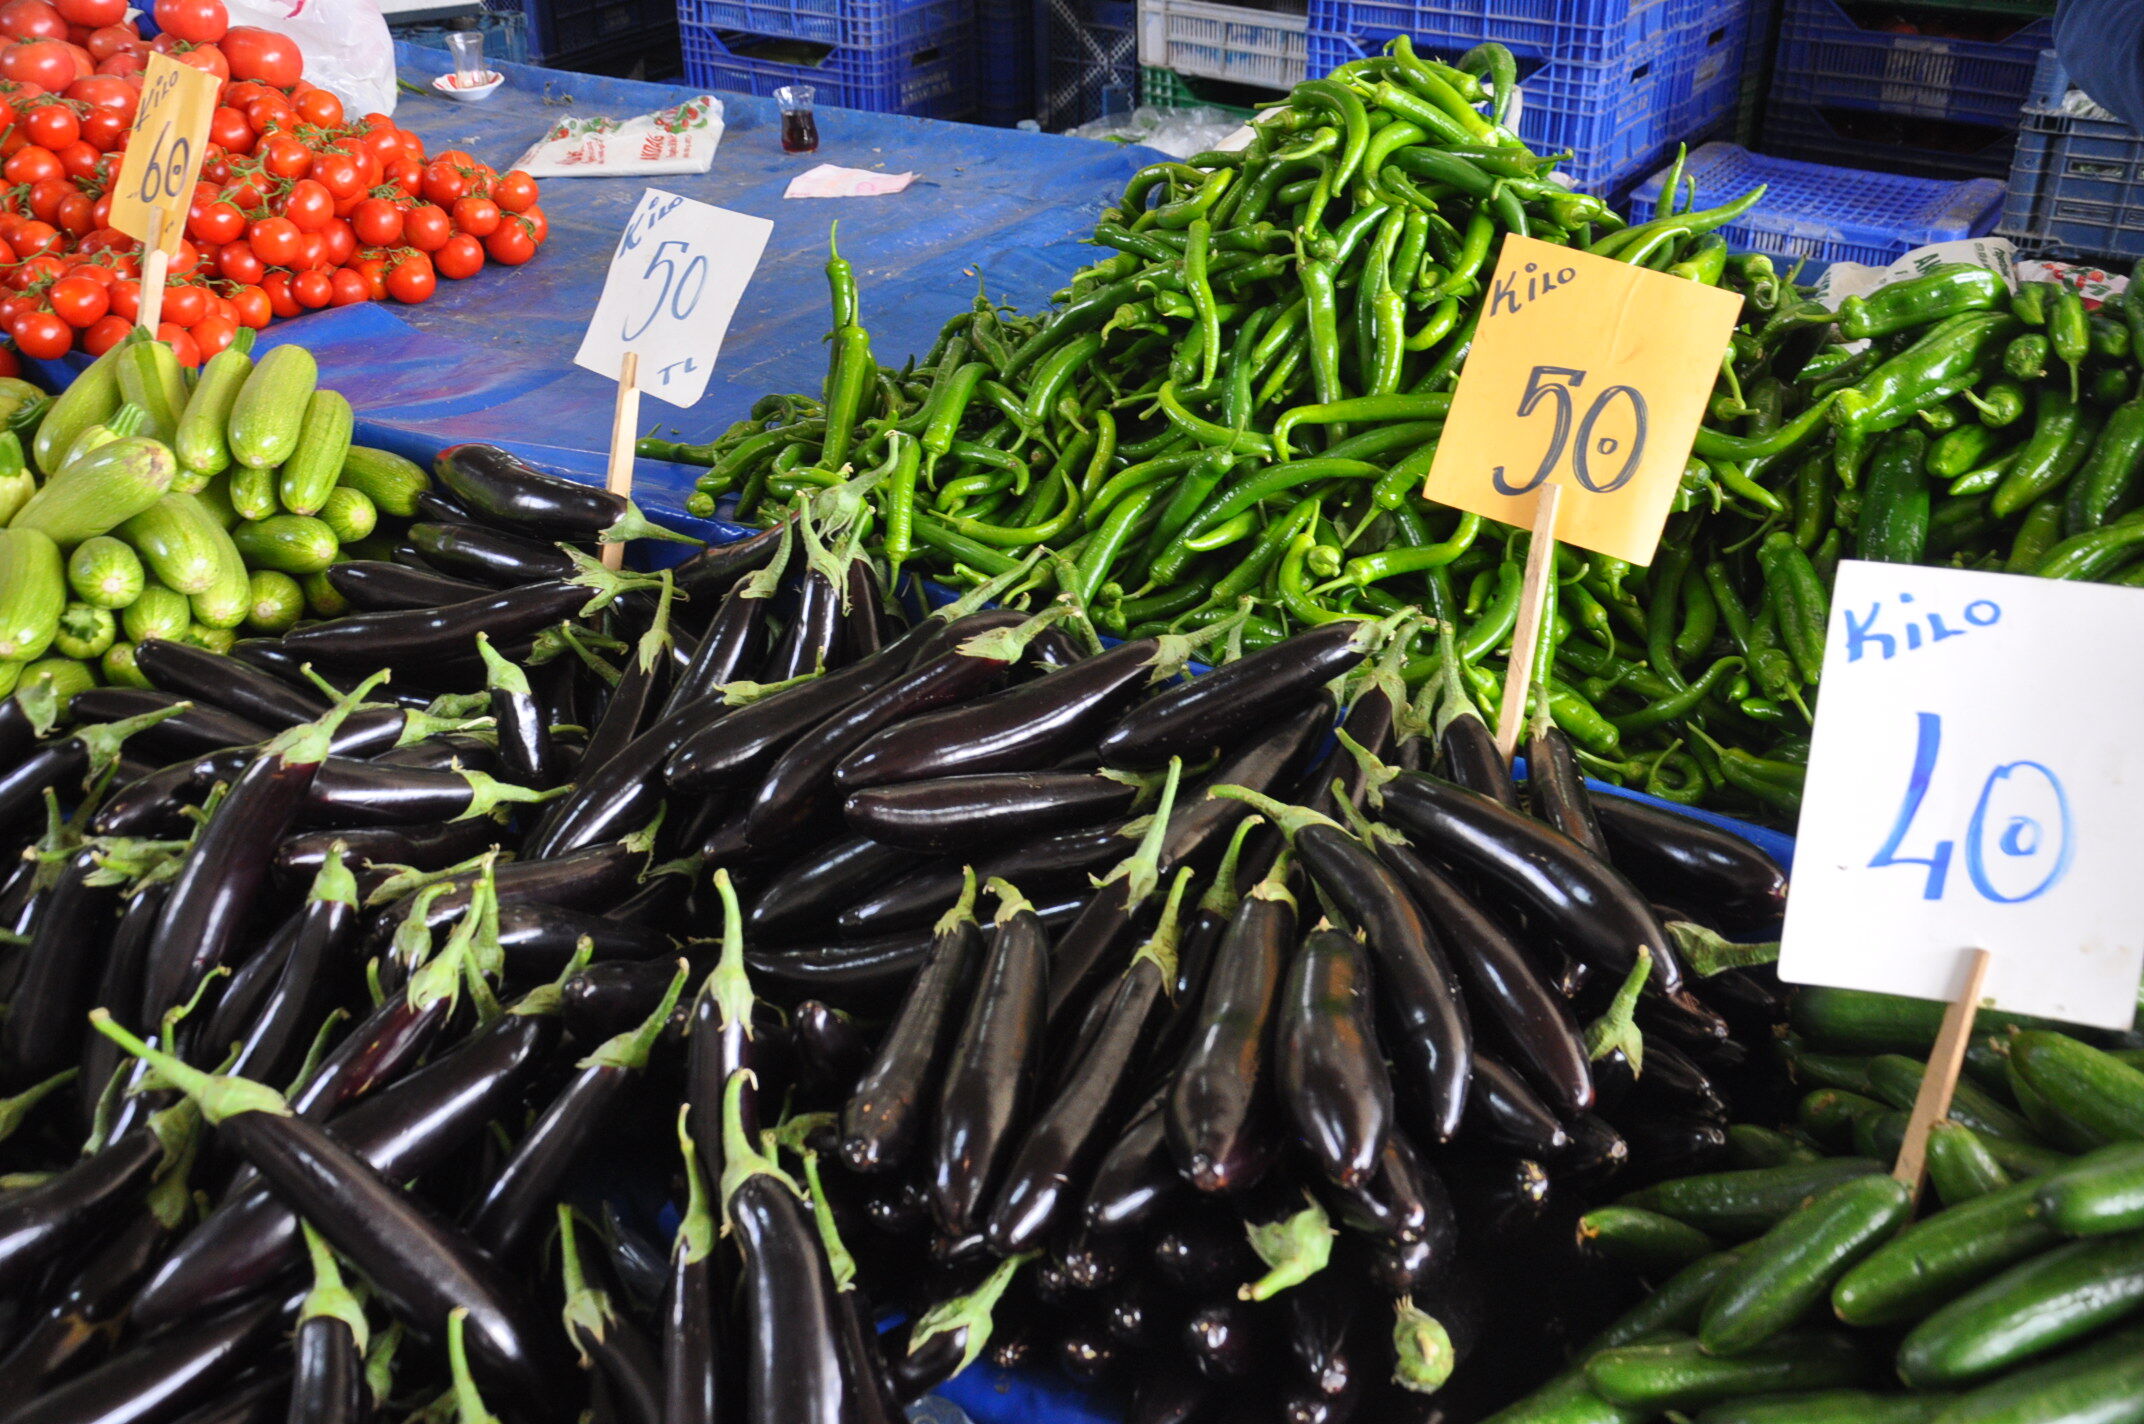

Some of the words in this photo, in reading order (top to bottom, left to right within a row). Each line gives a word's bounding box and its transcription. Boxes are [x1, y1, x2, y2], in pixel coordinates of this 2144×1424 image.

[141, 121, 190, 203] 60
[621, 240, 709, 342] 50
[657, 357, 698, 386] TL
[1492, 365, 1649, 496] 50
[1867, 711, 2077, 904] 40
